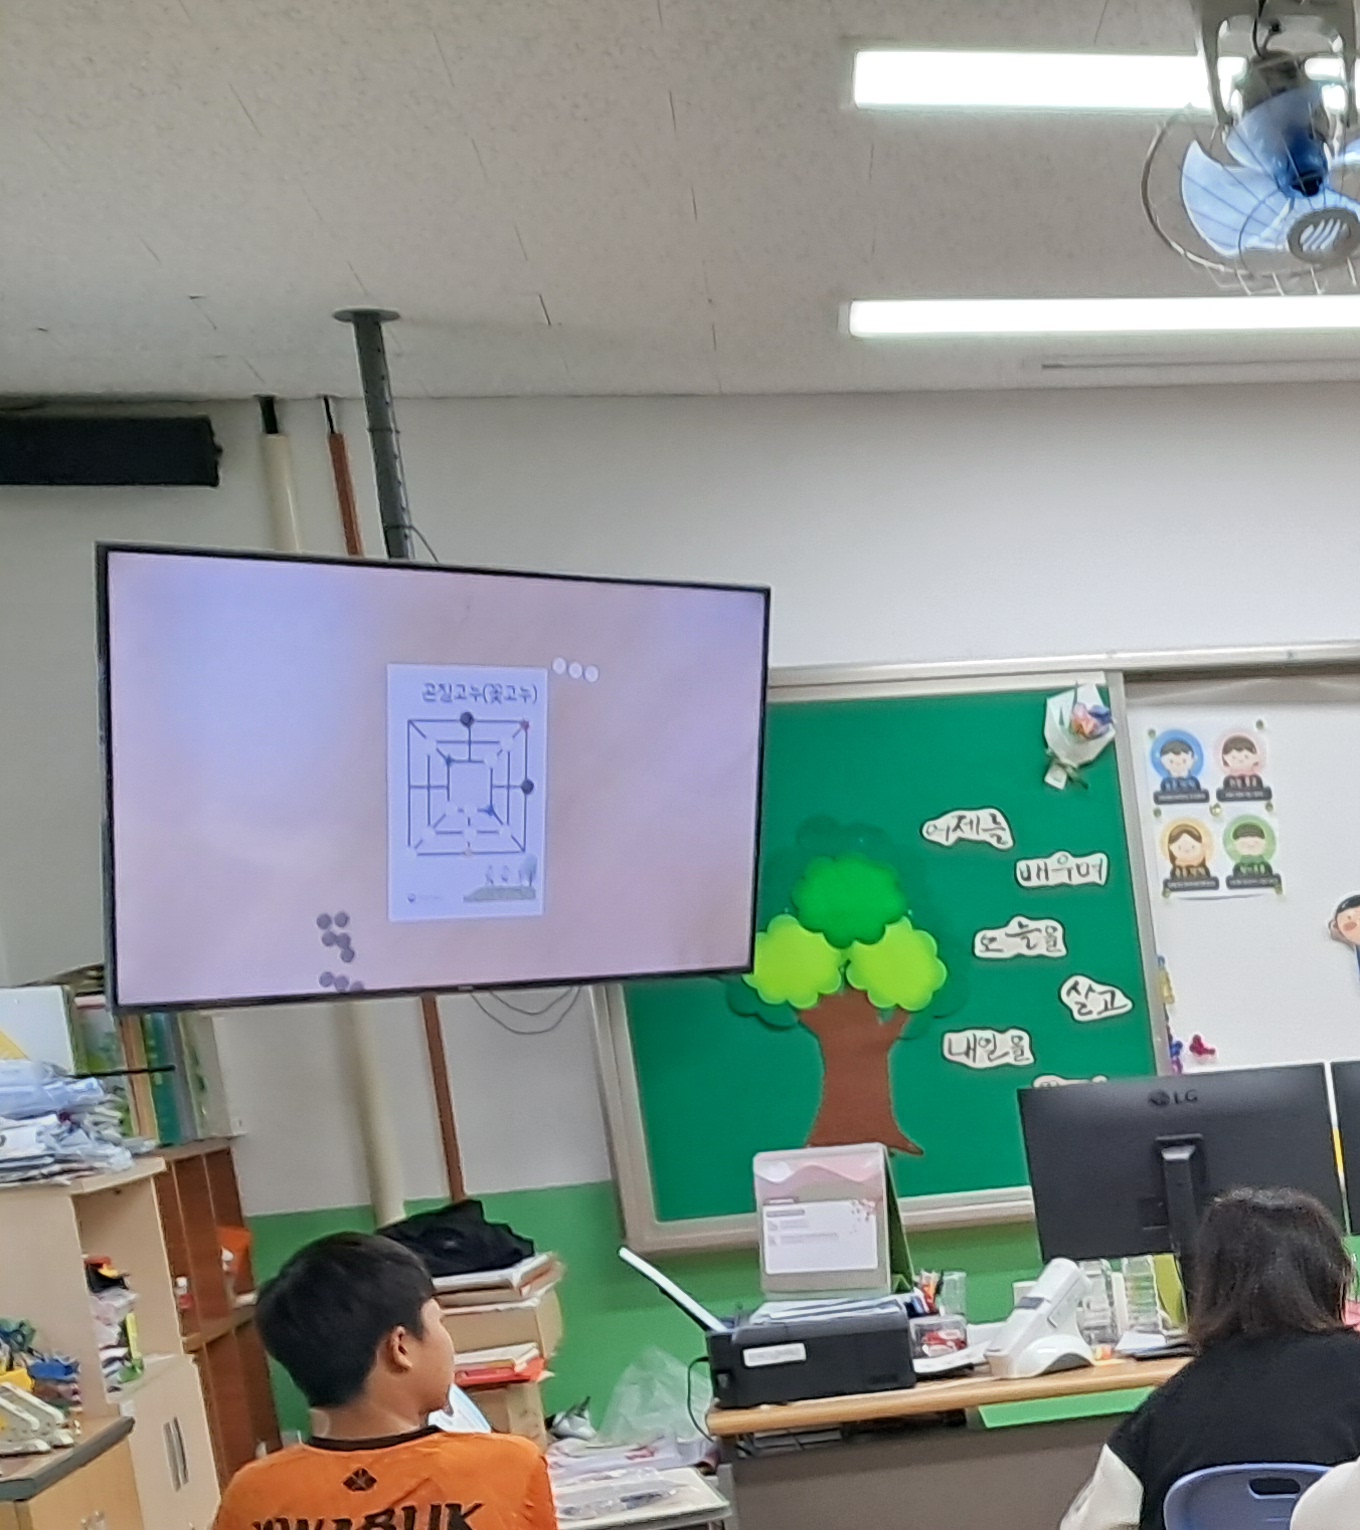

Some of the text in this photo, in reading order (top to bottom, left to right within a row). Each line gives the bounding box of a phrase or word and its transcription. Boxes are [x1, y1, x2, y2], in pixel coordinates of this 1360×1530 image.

[979, 920, 1062, 953] 오늘을
[1066, 980, 1129, 1017] 살고
[947, 1033, 1030, 1063] 내일을
